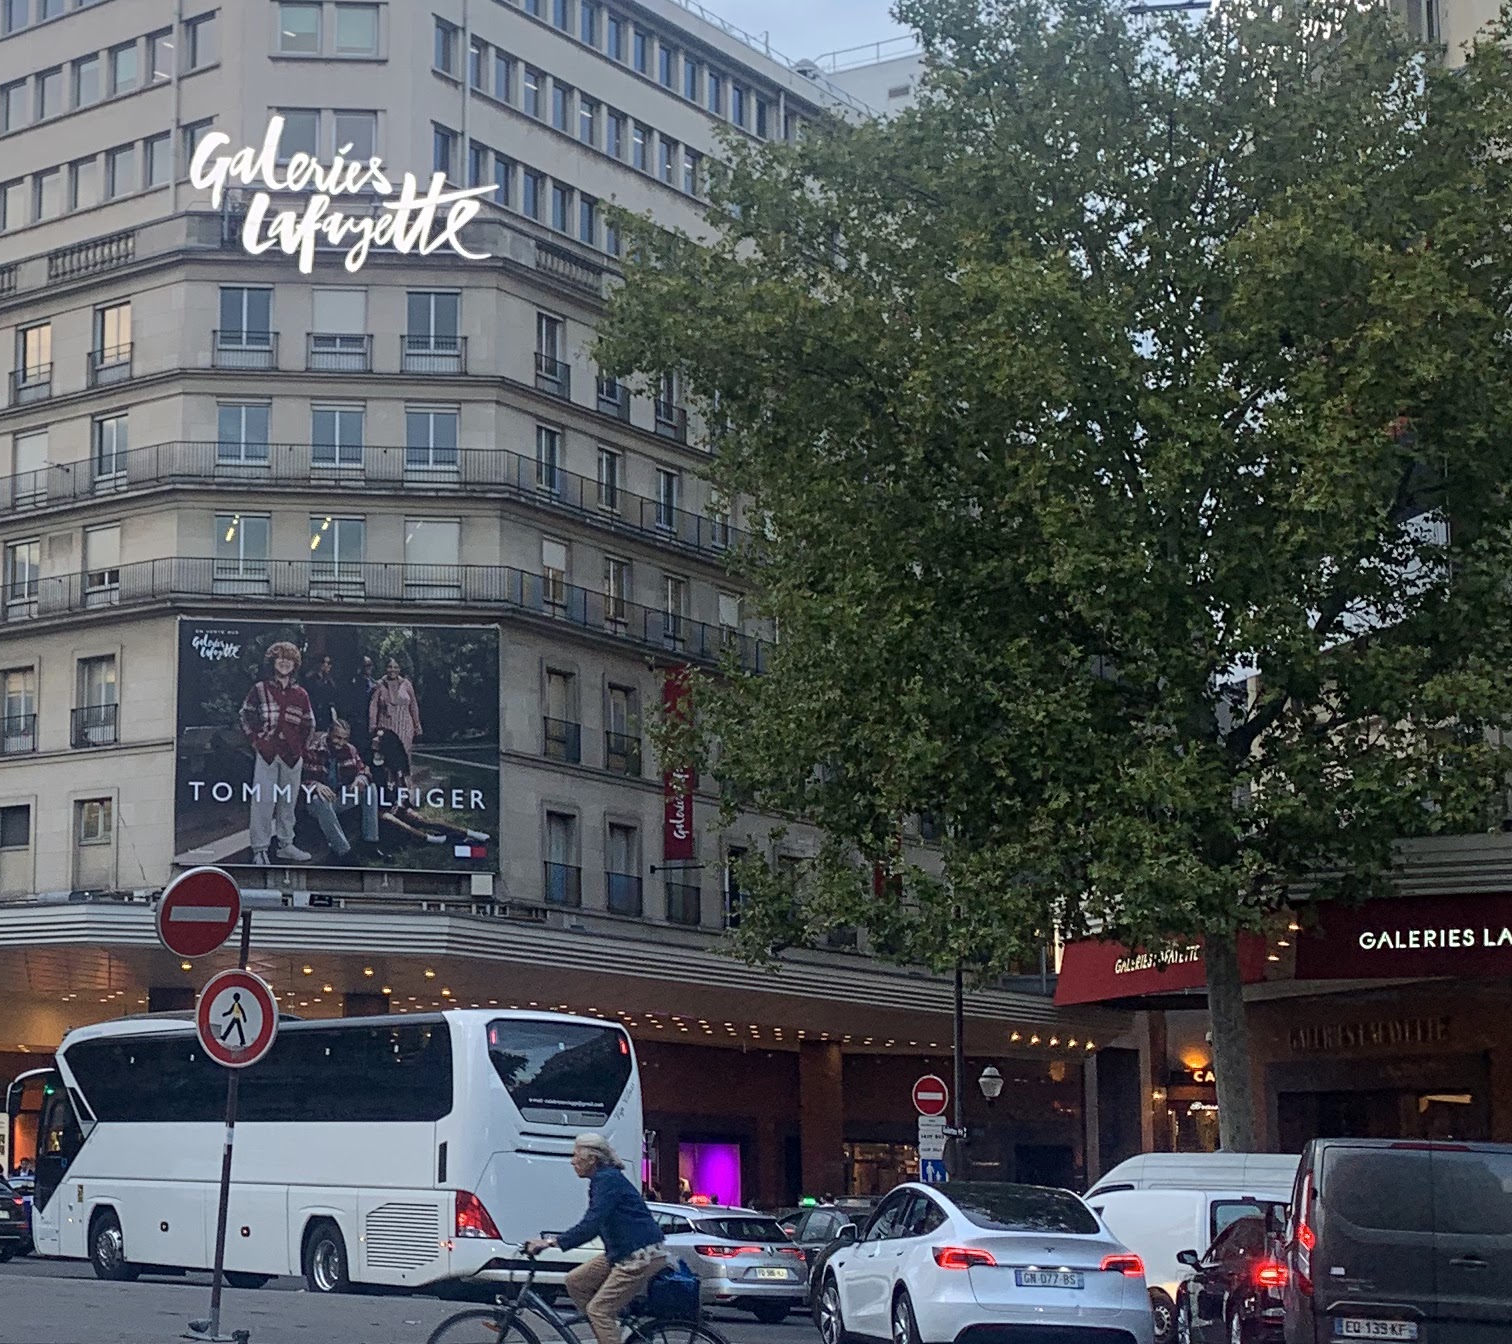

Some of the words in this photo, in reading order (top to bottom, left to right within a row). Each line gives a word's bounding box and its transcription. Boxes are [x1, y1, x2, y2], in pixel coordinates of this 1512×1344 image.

[189, 116, 392, 209] Galeries
[242, 172, 499, 274] Lafayette
[189, 781, 317, 805] TOMMY
[342, 784, 486, 810] HILFIGER
[1359, 928, 1475, 950] GALERIES
